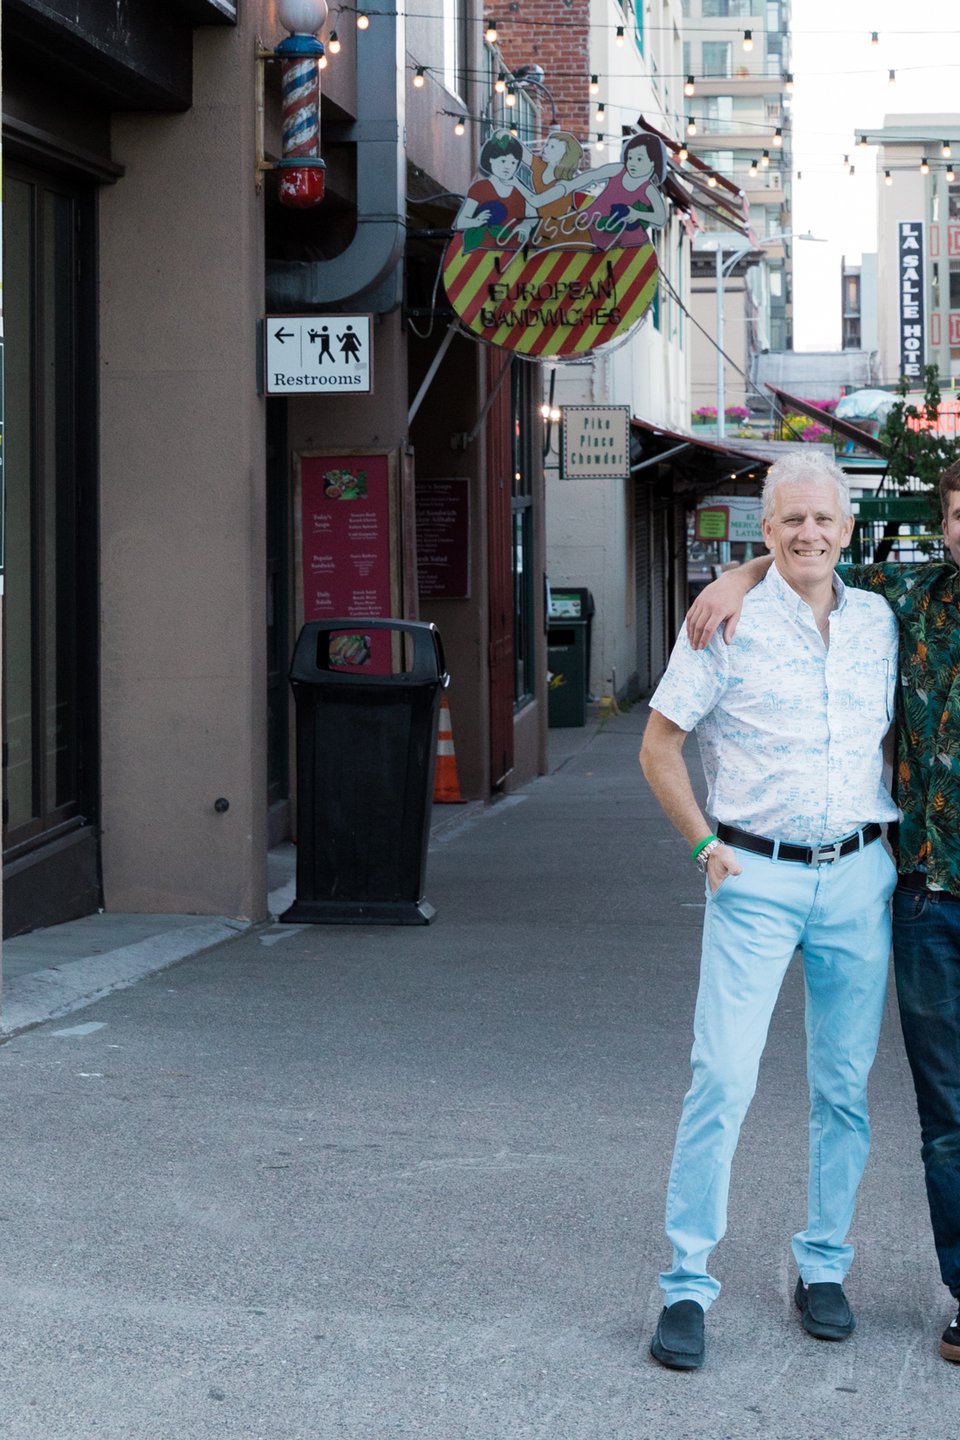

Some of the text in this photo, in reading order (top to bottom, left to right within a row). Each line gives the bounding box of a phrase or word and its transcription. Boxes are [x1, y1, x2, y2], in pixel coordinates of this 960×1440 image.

[488, 280, 612, 302] EUROPEAN
[902, 224, 922, 377] LA SALLE HOTE
[480, 307, 621, 329] SANDWICHES
[273, 373, 362, 386] Restrooms
[584, 417, 610, 429] Pike
[580, 435, 614, 447] Place
[571, 452, 623, 464] Chowder
[731, 521, 762, 529] MERCA
[736, 529, 763, 537] LATIN
